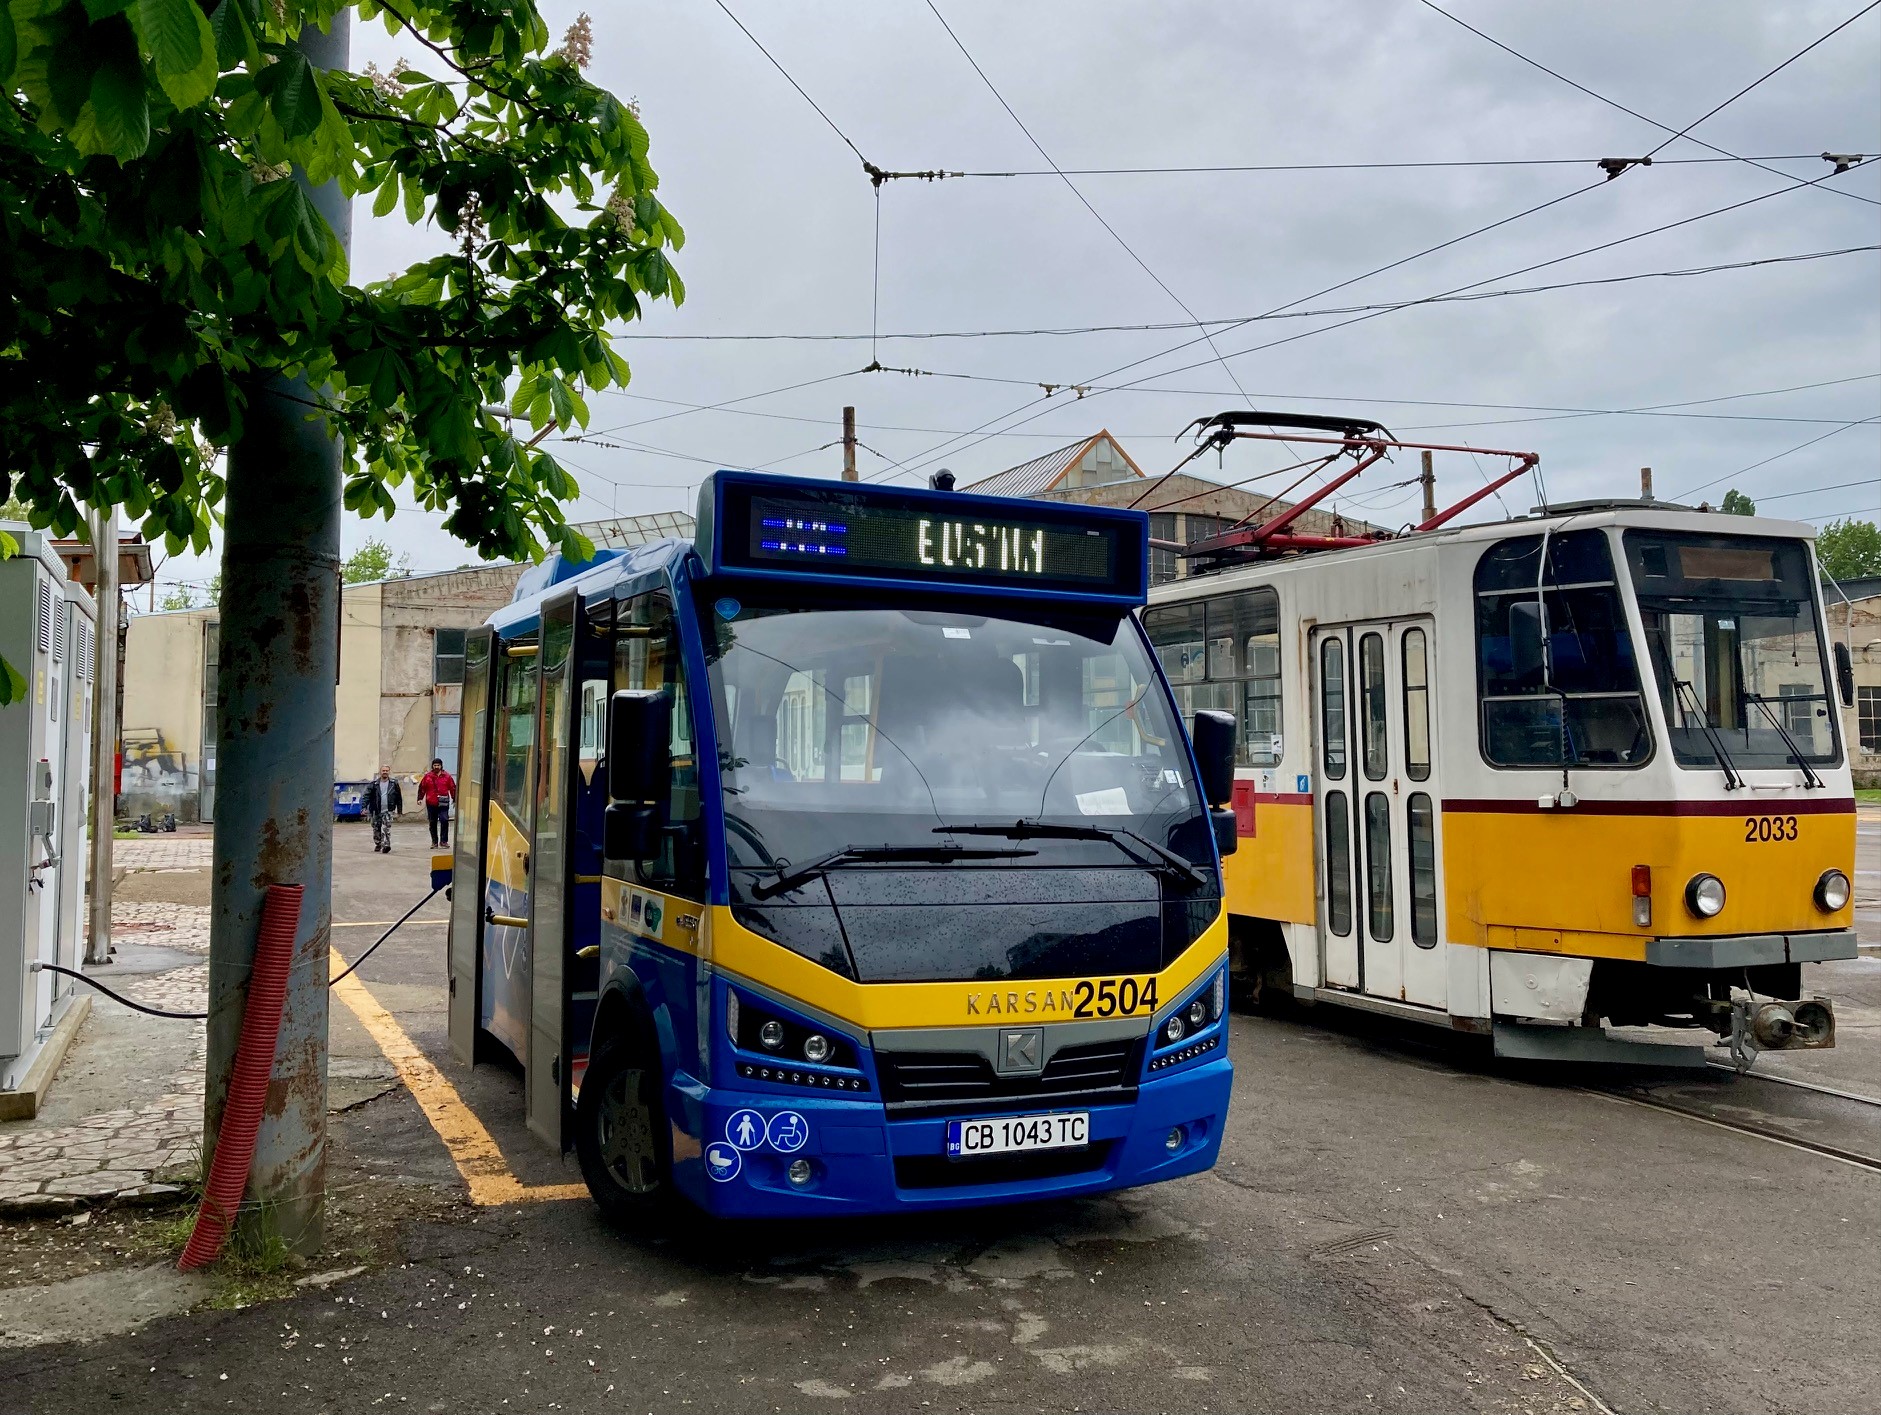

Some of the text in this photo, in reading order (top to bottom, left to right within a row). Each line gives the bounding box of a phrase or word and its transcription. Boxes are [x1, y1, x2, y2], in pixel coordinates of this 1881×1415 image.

[1745, 816, 1798, 843] 2033
[967, 990, 1073, 1015] KARSAN
[1073, 977, 1158, 1018] 2504
[950, 1142, 960, 1151] BG
[965, 1117, 1085, 1150] CB 1043 TC
